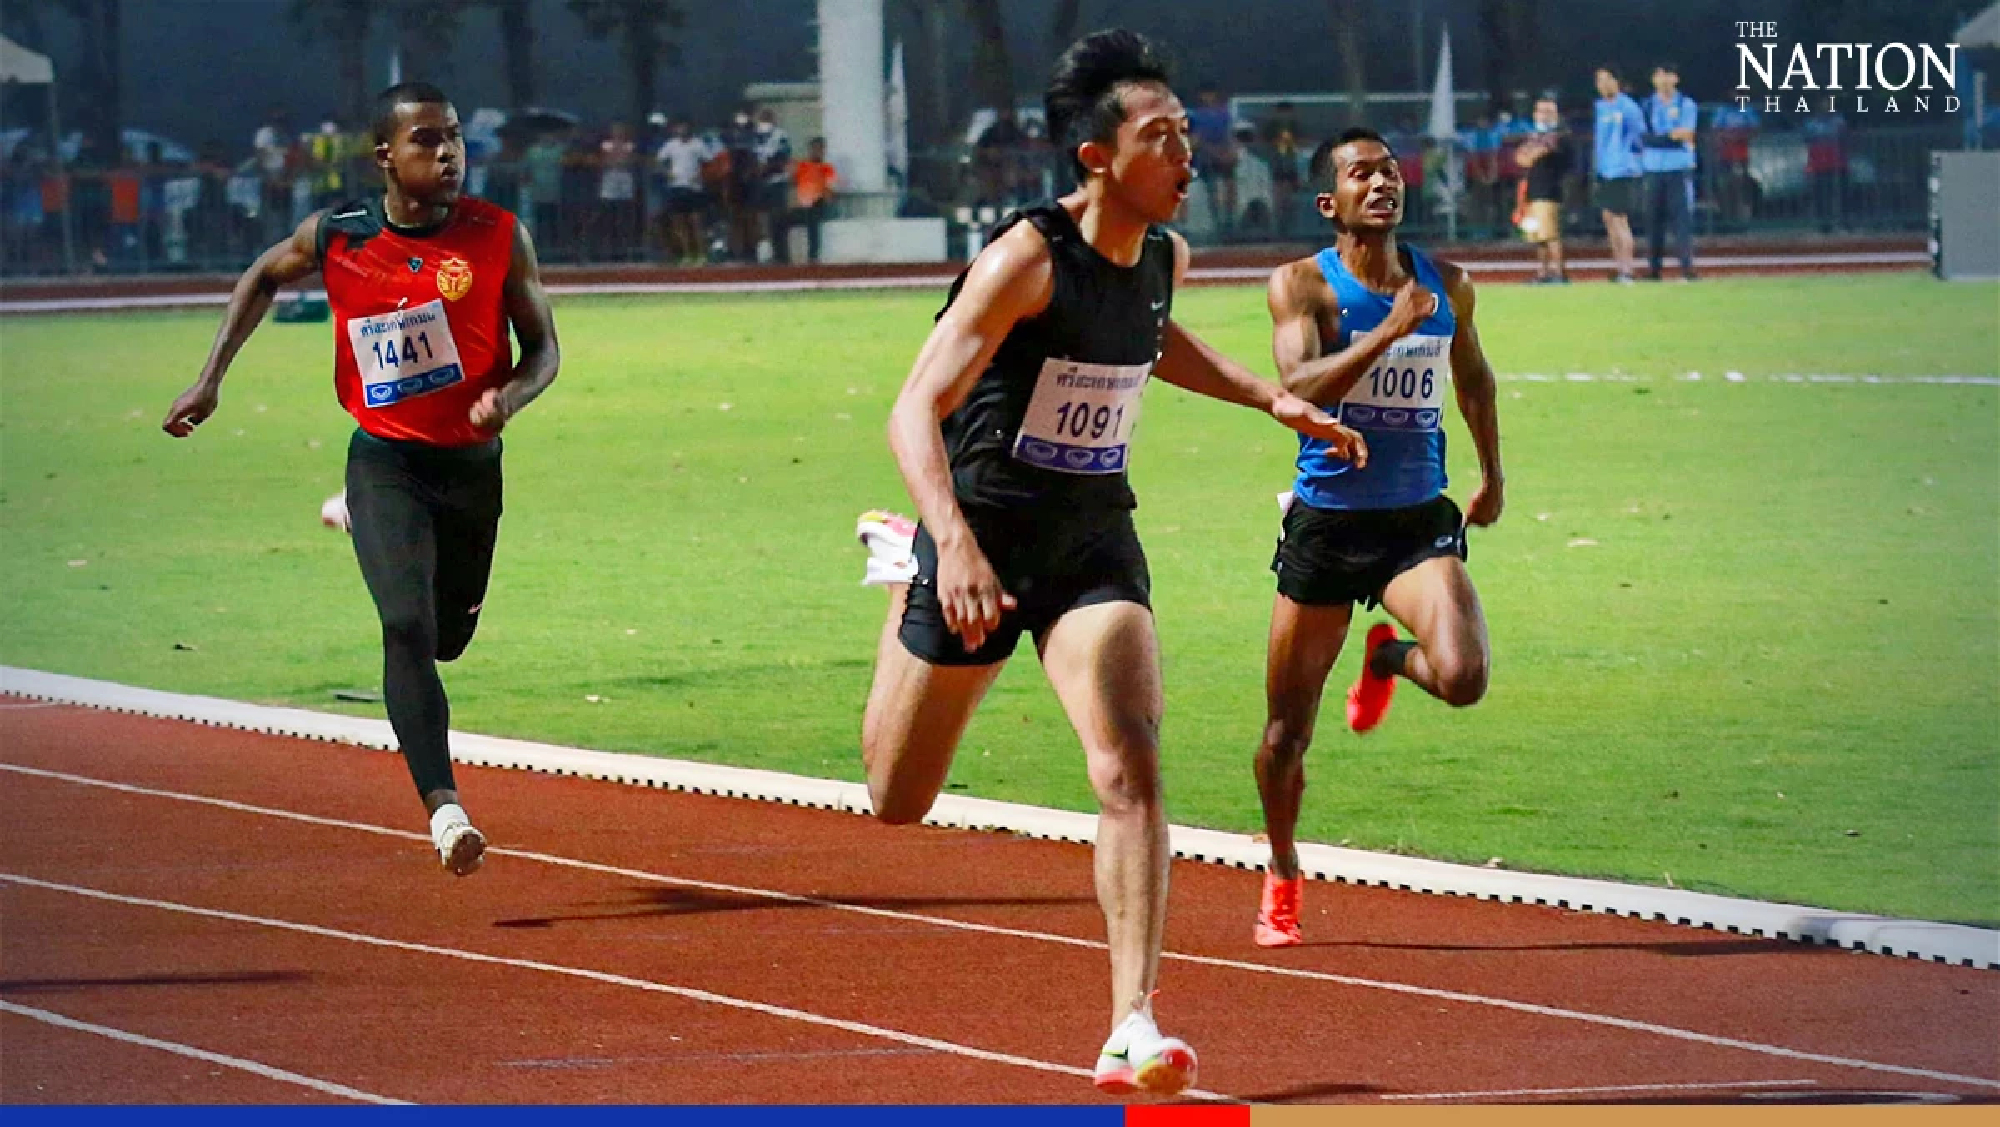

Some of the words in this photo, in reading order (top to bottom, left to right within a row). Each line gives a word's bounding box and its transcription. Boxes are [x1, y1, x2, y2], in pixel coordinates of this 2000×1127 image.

[373, 332, 432, 370] 1441
[1369, 366, 1434, 399] 1006
[1056, 401, 1124, 439] 1091
